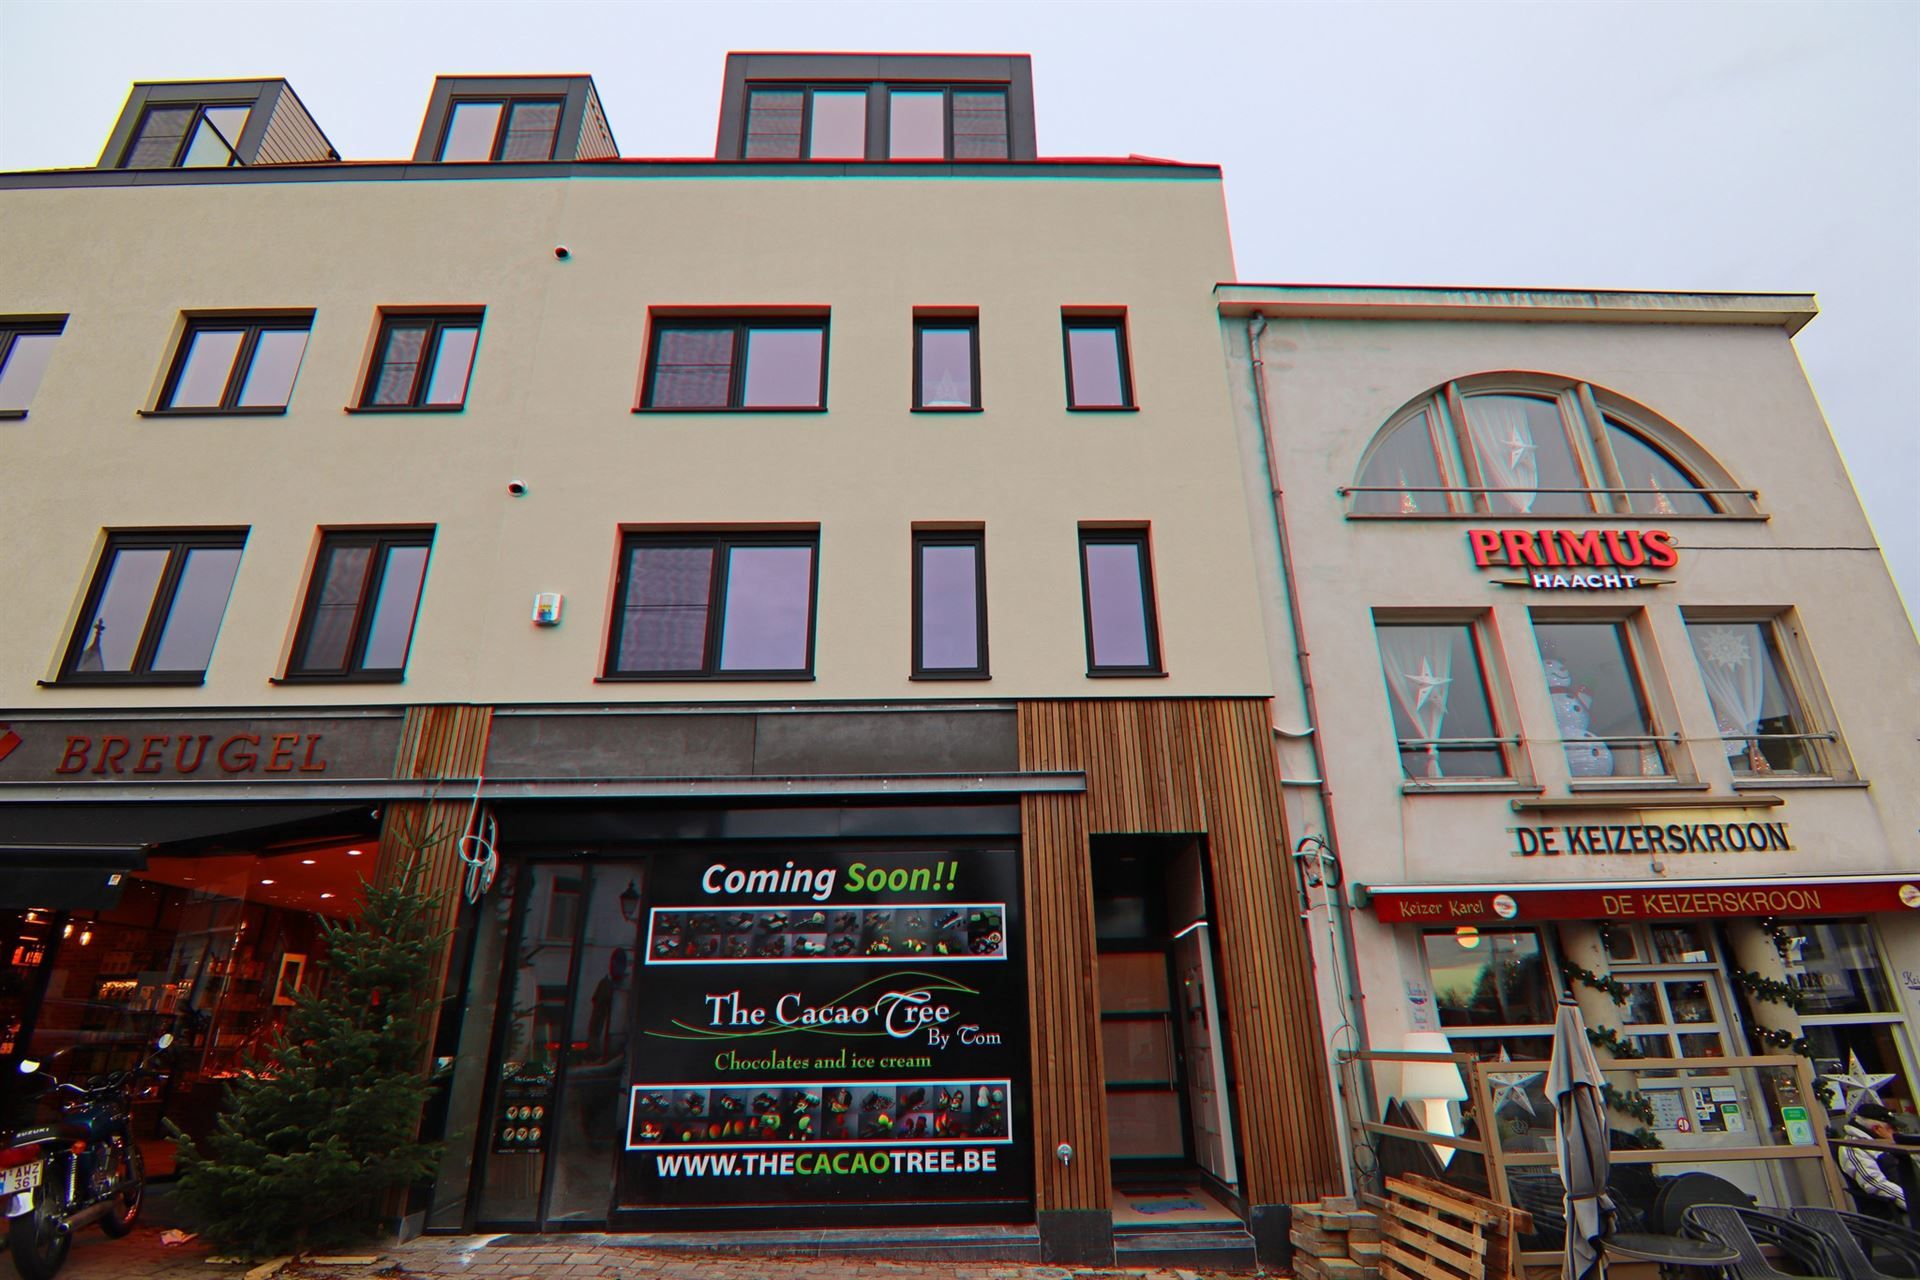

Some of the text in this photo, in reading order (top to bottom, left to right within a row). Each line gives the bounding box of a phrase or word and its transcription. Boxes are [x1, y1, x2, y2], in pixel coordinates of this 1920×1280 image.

[1468, 530, 1679, 568] PRIMUS
[1533, 574, 1636, 589] HAACHT
[55, 733, 327, 774] BREUGEL
[1517, 822, 1791, 856] DE KEIZERSKROON
[702, 861, 958, 901] Coming Soon!!
[1399, 901, 1443, 917] Keizer
[1449, 900, 1484, 916] Karel
[1602, 890, 1821, 914] DE KEIZERSKROON
[705, 990, 950, 1038] The Cacao Tree
[927, 1024, 1001, 1050] By Tom
[715, 1049, 932, 1071] Chocolates and ice cream
[656, 1150, 997, 1177] WWW.THECACAOTREE.BE
[14, 1174, 38, 1190] 361
